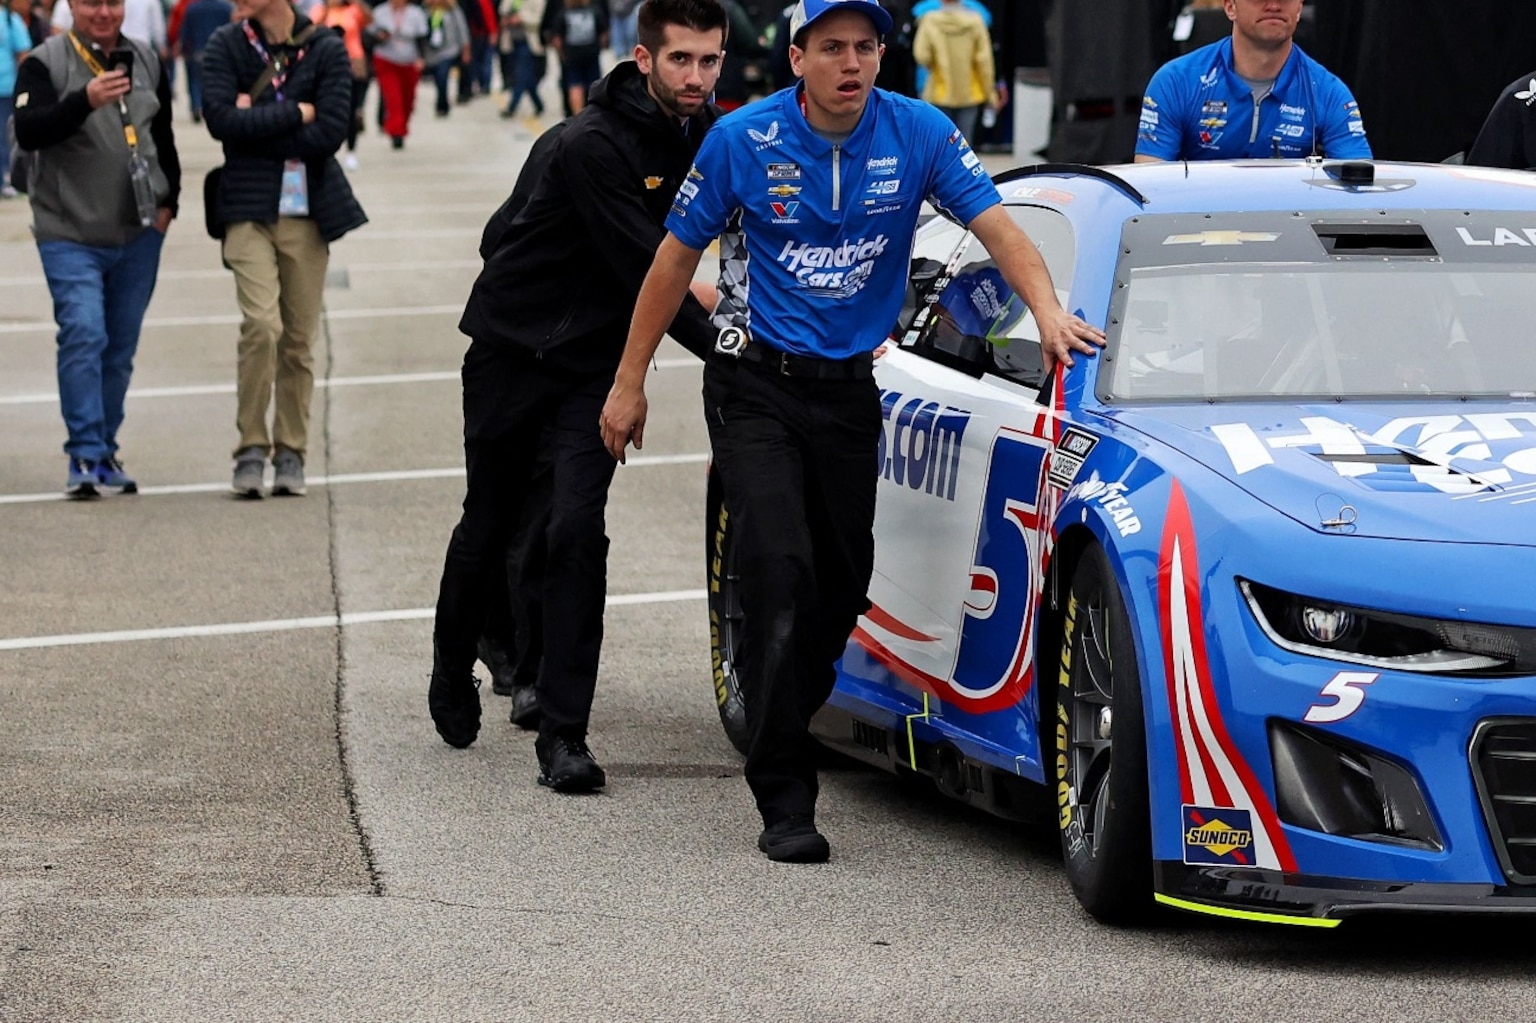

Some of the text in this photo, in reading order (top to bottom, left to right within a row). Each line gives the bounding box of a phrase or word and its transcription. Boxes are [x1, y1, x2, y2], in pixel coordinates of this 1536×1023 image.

[866, 155, 899, 171] Hendrick
[776, 233, 890, 273] Hendrick
[795, 259, 875, 289] Cars.com
[949, 428, 1051, 698] 5
[1303, 671, 1381, 724] 5
[1189, 829, 1249, 846] SUNOCO
